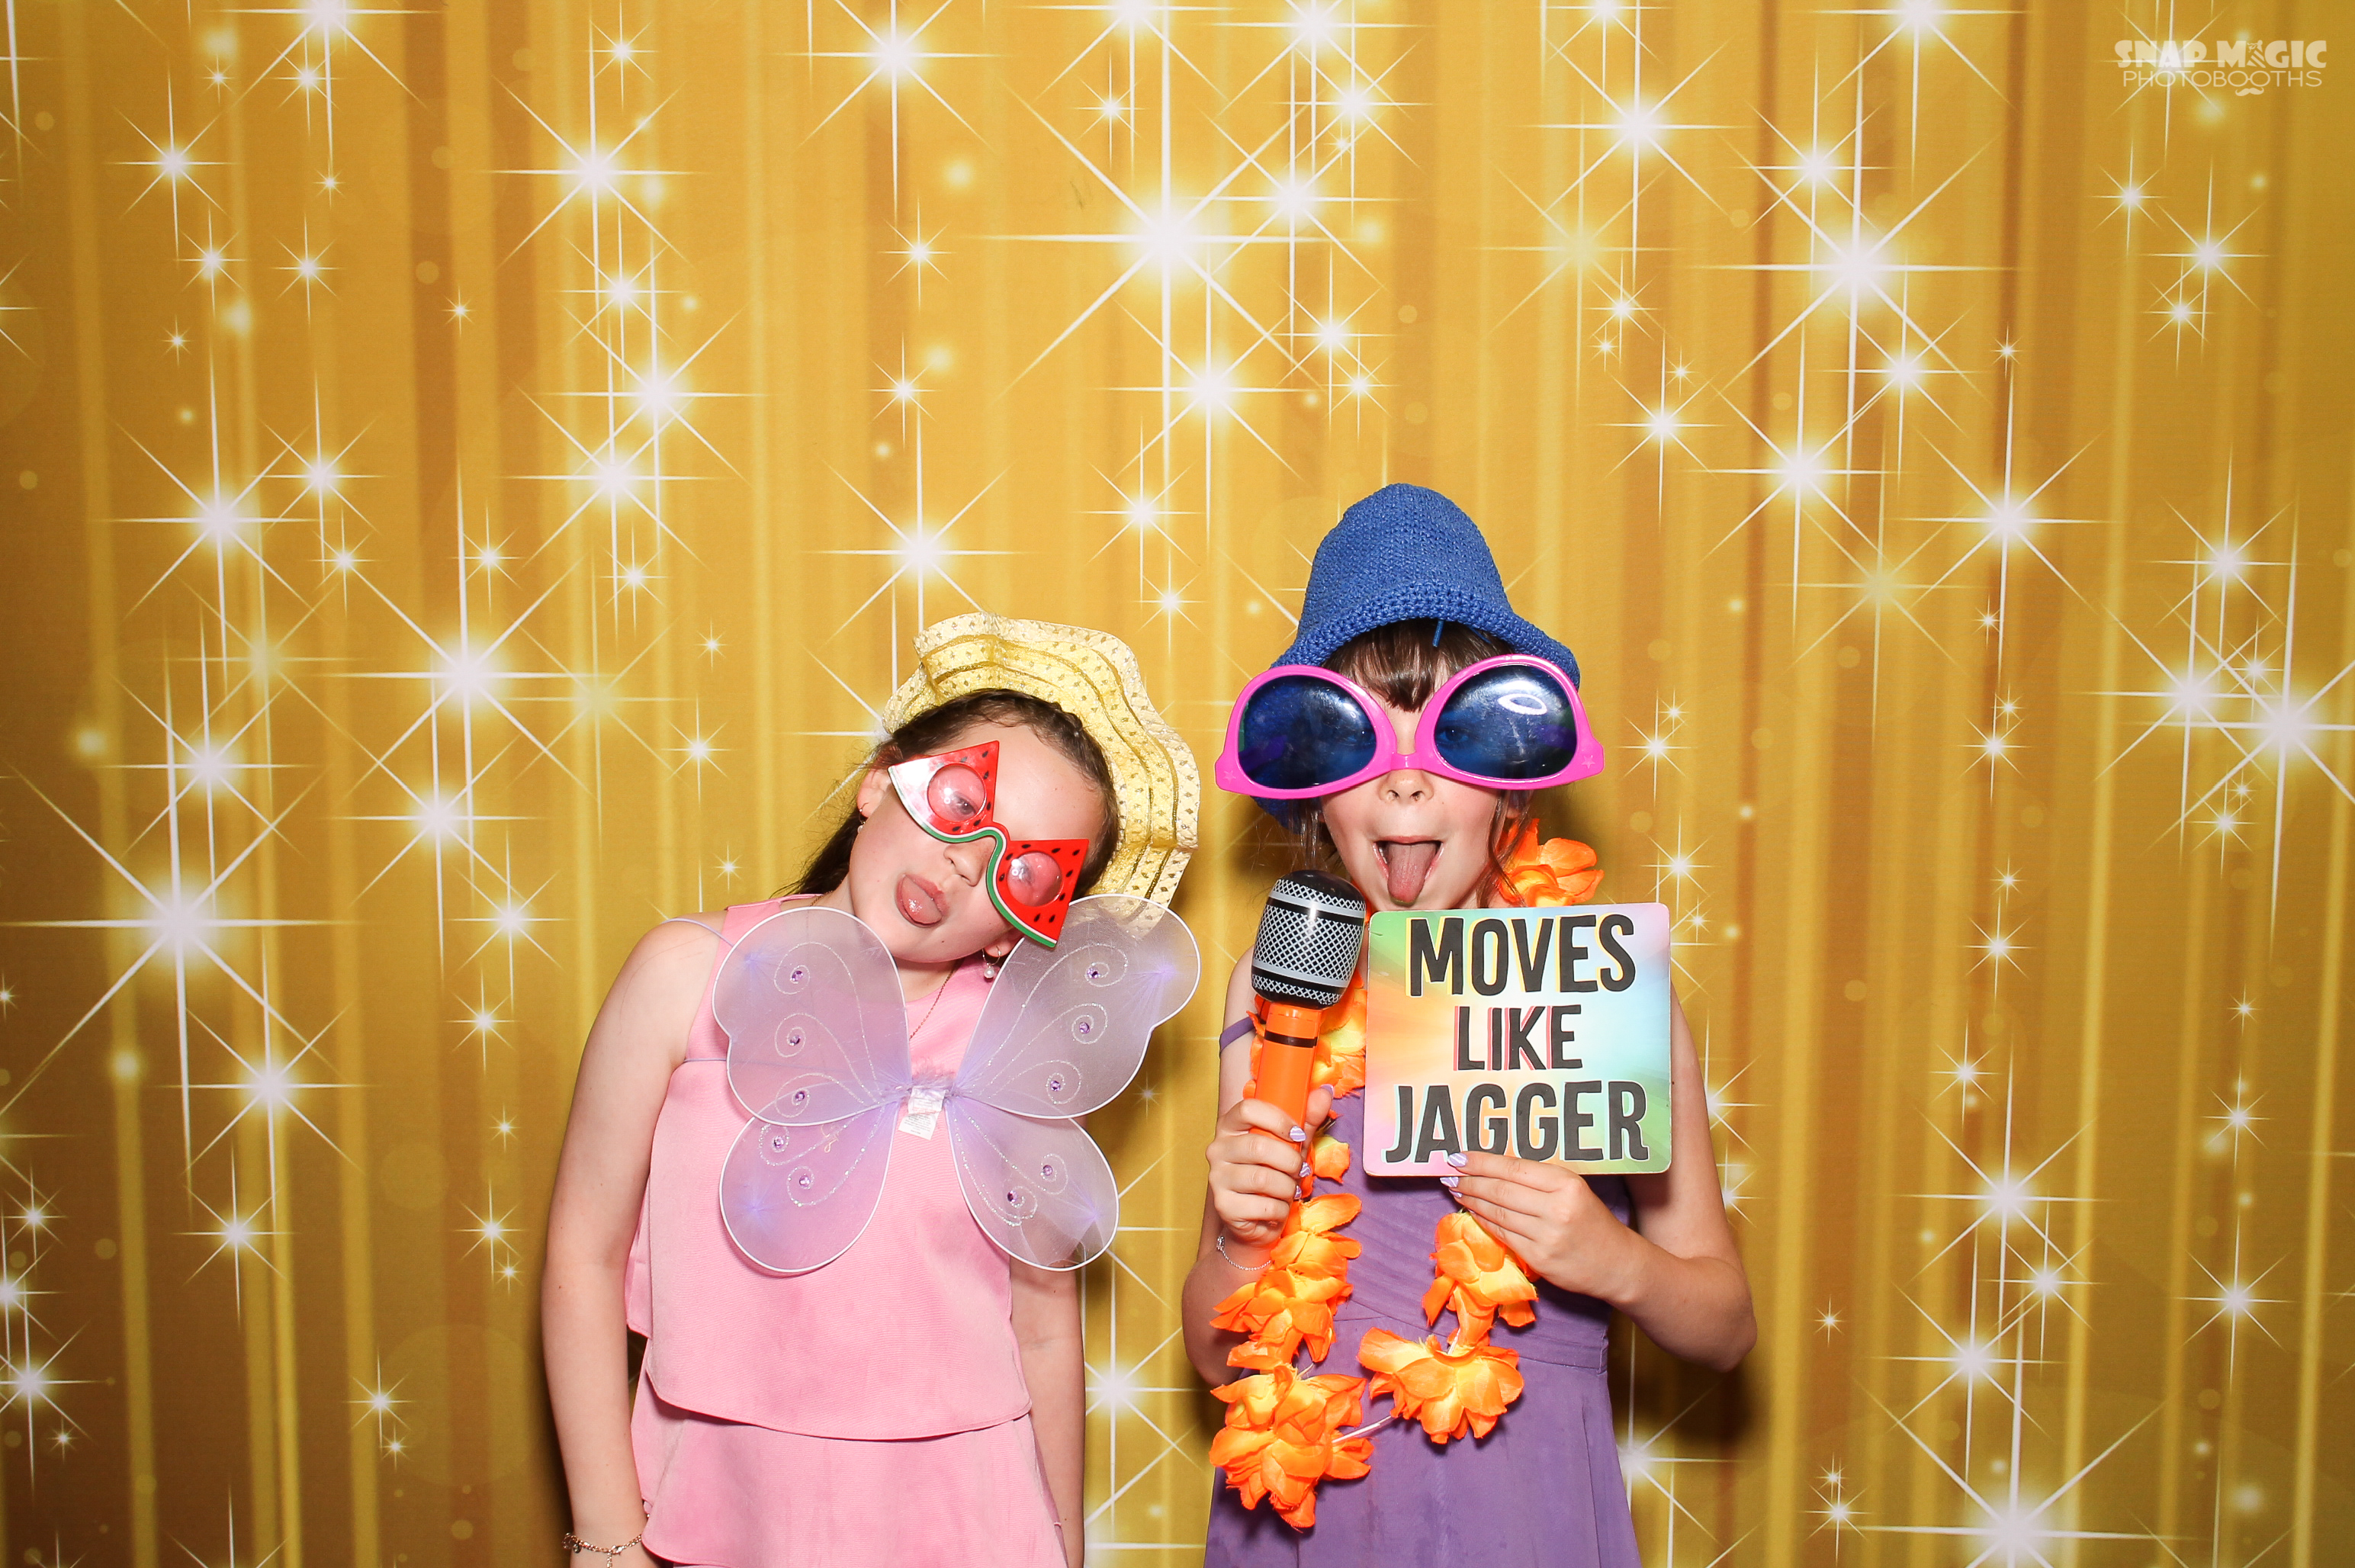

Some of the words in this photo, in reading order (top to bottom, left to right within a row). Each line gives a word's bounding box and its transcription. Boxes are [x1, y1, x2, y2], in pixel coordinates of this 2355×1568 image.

[1406, 914, 1637, 997] MOVES
[1454, 1004, 1583, 1072] LIKE
[1382, 1080, 1650, 1163] JAGGER
